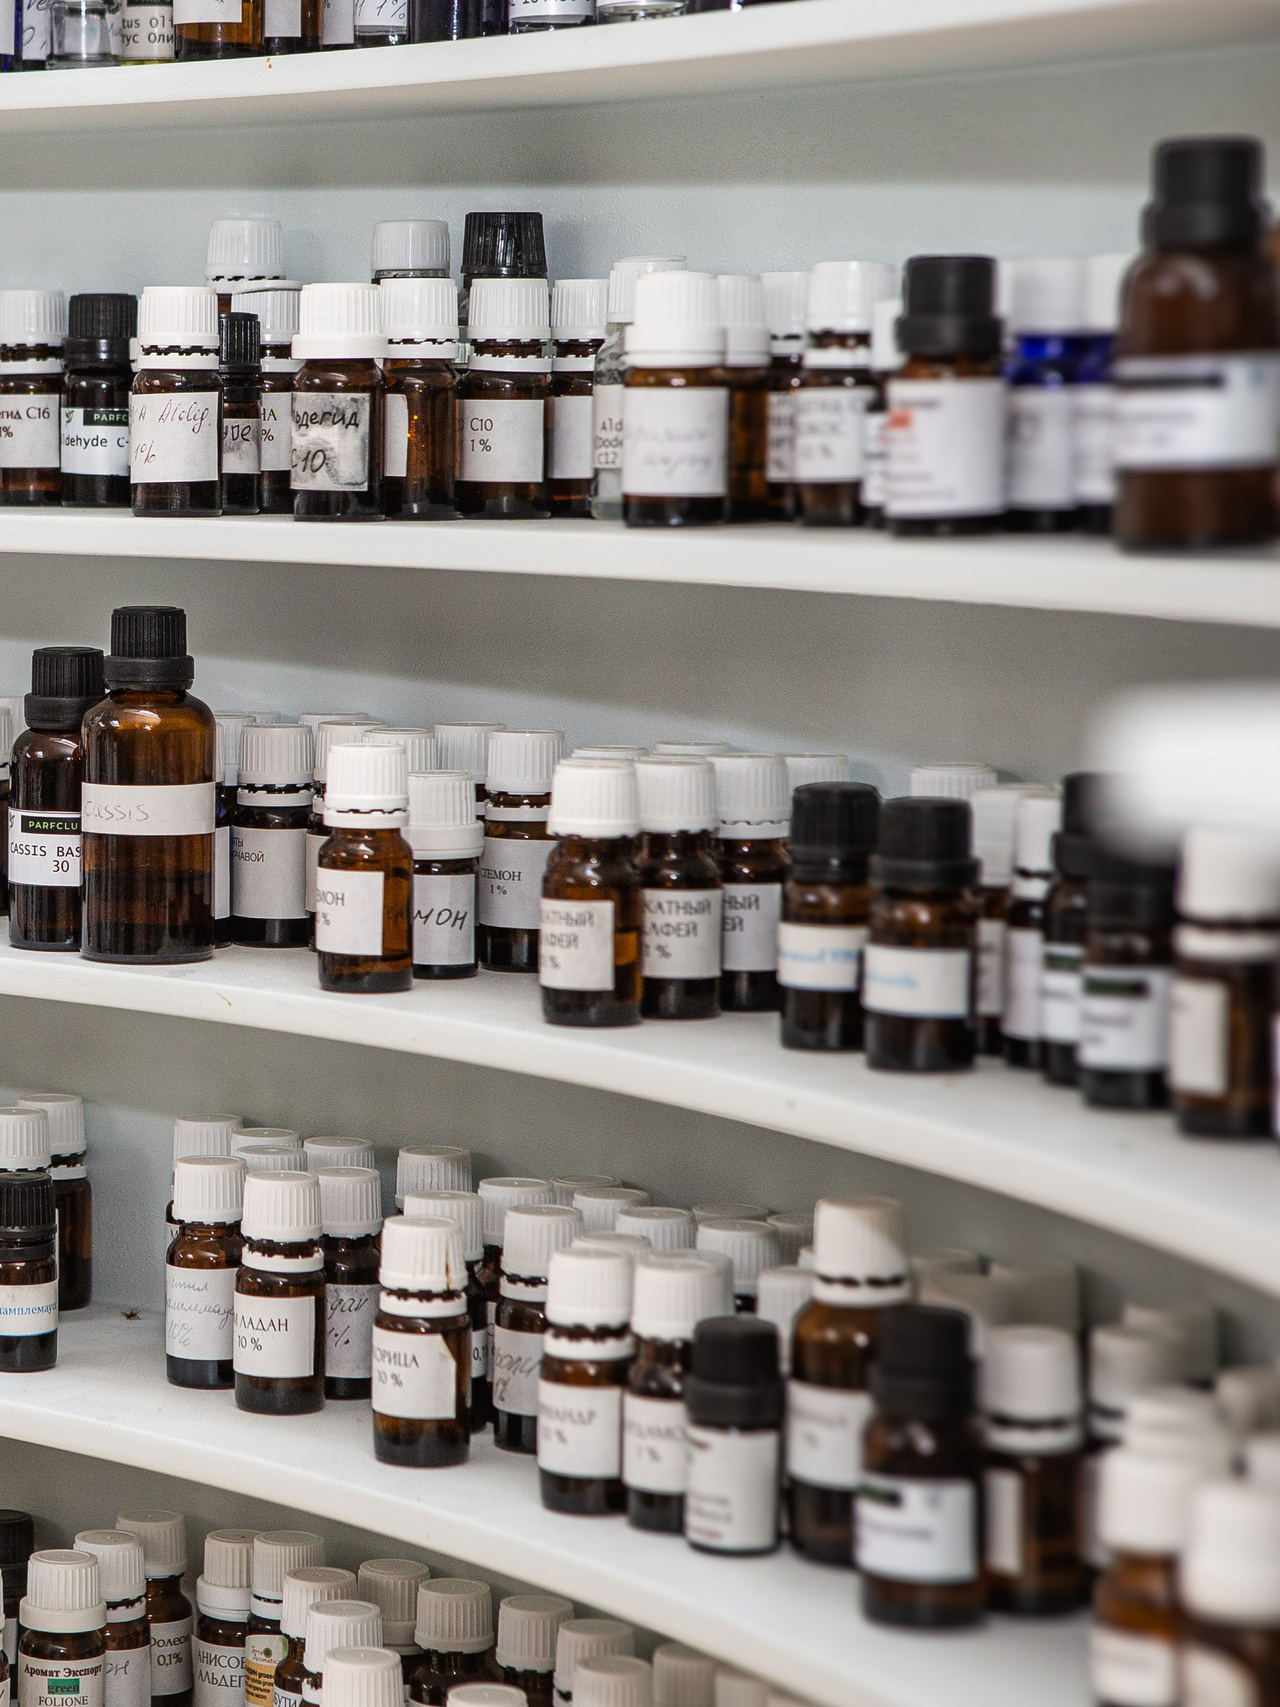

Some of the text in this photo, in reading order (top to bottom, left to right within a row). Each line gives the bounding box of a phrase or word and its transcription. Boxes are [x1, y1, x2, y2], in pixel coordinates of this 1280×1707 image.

[28, 820, 79, 831] PARFCLU
[10, 841, 82, 858] CASSIS BAS
[52, 860, 70, 873] 30
[239, 1317, 289, 1332] ЛАДАН
[237, 1336, 263, 1351] 10 %
[156, 1651, 183, 1667] 0,1%
[24, 1663, 103, 1678] Аромат Экспорт
[47, 1682, 80, 1695] green
[37, 1695, 89, 1707] FOLIONE
